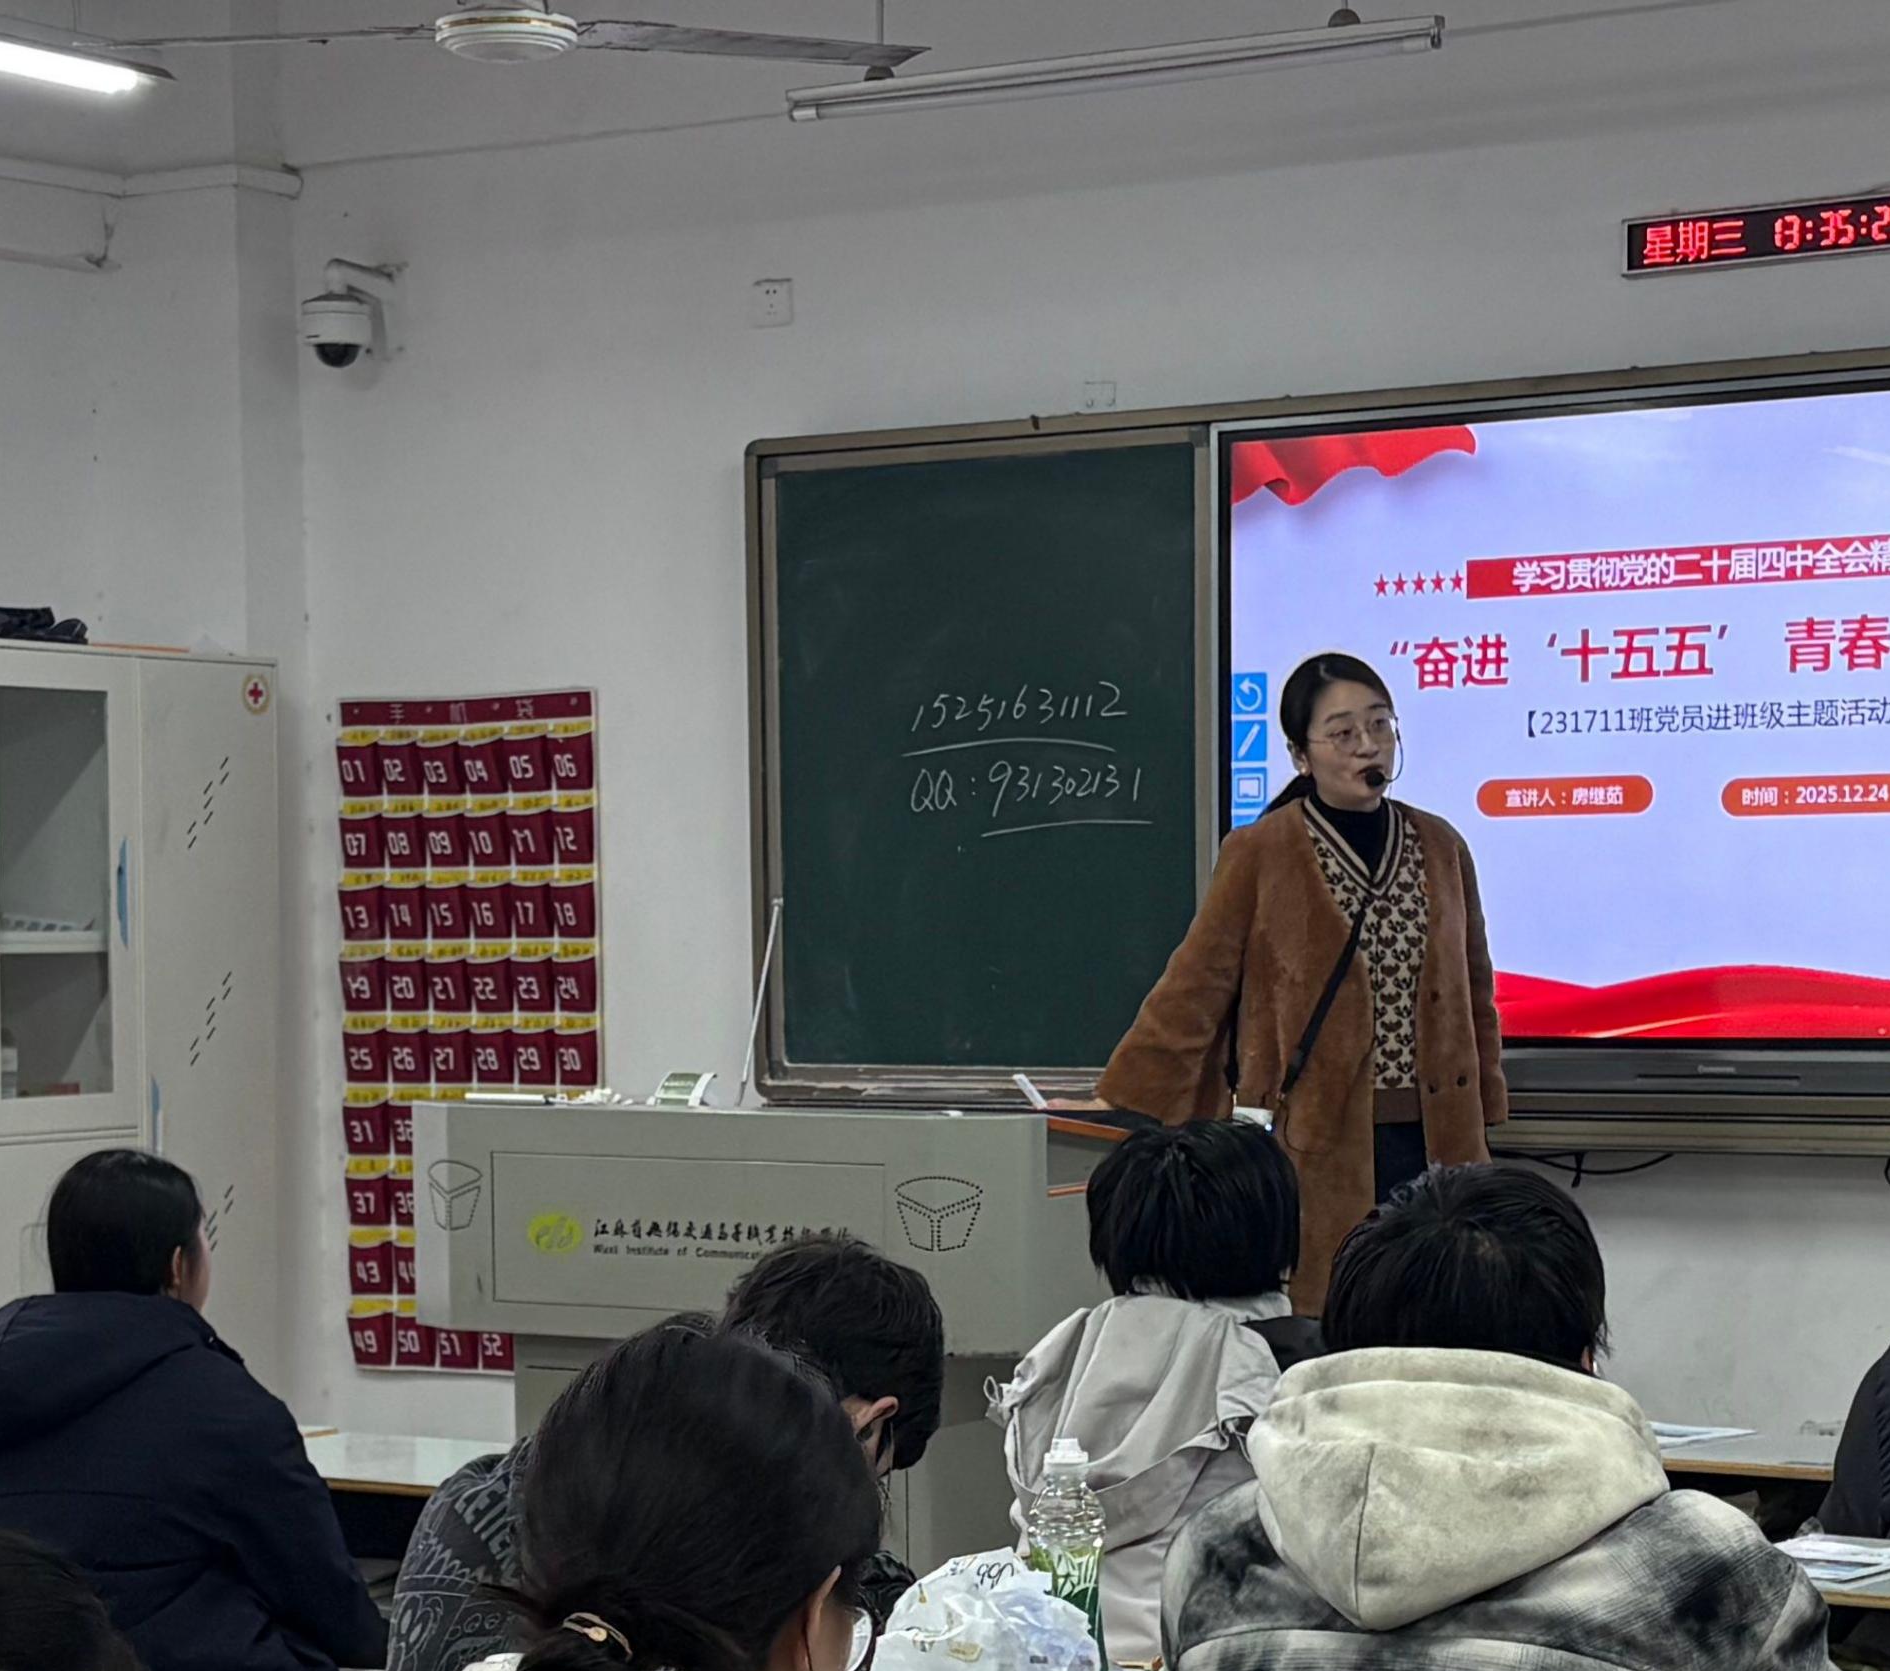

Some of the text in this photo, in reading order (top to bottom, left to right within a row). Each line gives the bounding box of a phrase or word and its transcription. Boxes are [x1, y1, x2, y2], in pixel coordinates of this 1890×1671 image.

[1643, 219, 1746, 265] 星期三
[910, 680, 1128, 732] 15251631112
[341, 754, 577, 783] 01 02 03 04 05 06
[988, 760, 1141, 817] 931302131
[345, 827, 577, 856] 07 08 09 10 11 12
[345, 902, 576, 928] 13 14 15 16 17 18
[347, 976, 580, 1000] 19 20 21 22 23 24
[350, 1047, 581, 1071] 25 26 27 28 29 30
[350, 1120, 373, 1142] 31
[353, 1192, 376, 1214] 37
[625, 1244, 670, 1256] Institute
[676, 1246, 688, 1257] of
[357, 1261, 380, 1283] 43
[355, 1330, 503, 1356] 49 50 51 52
